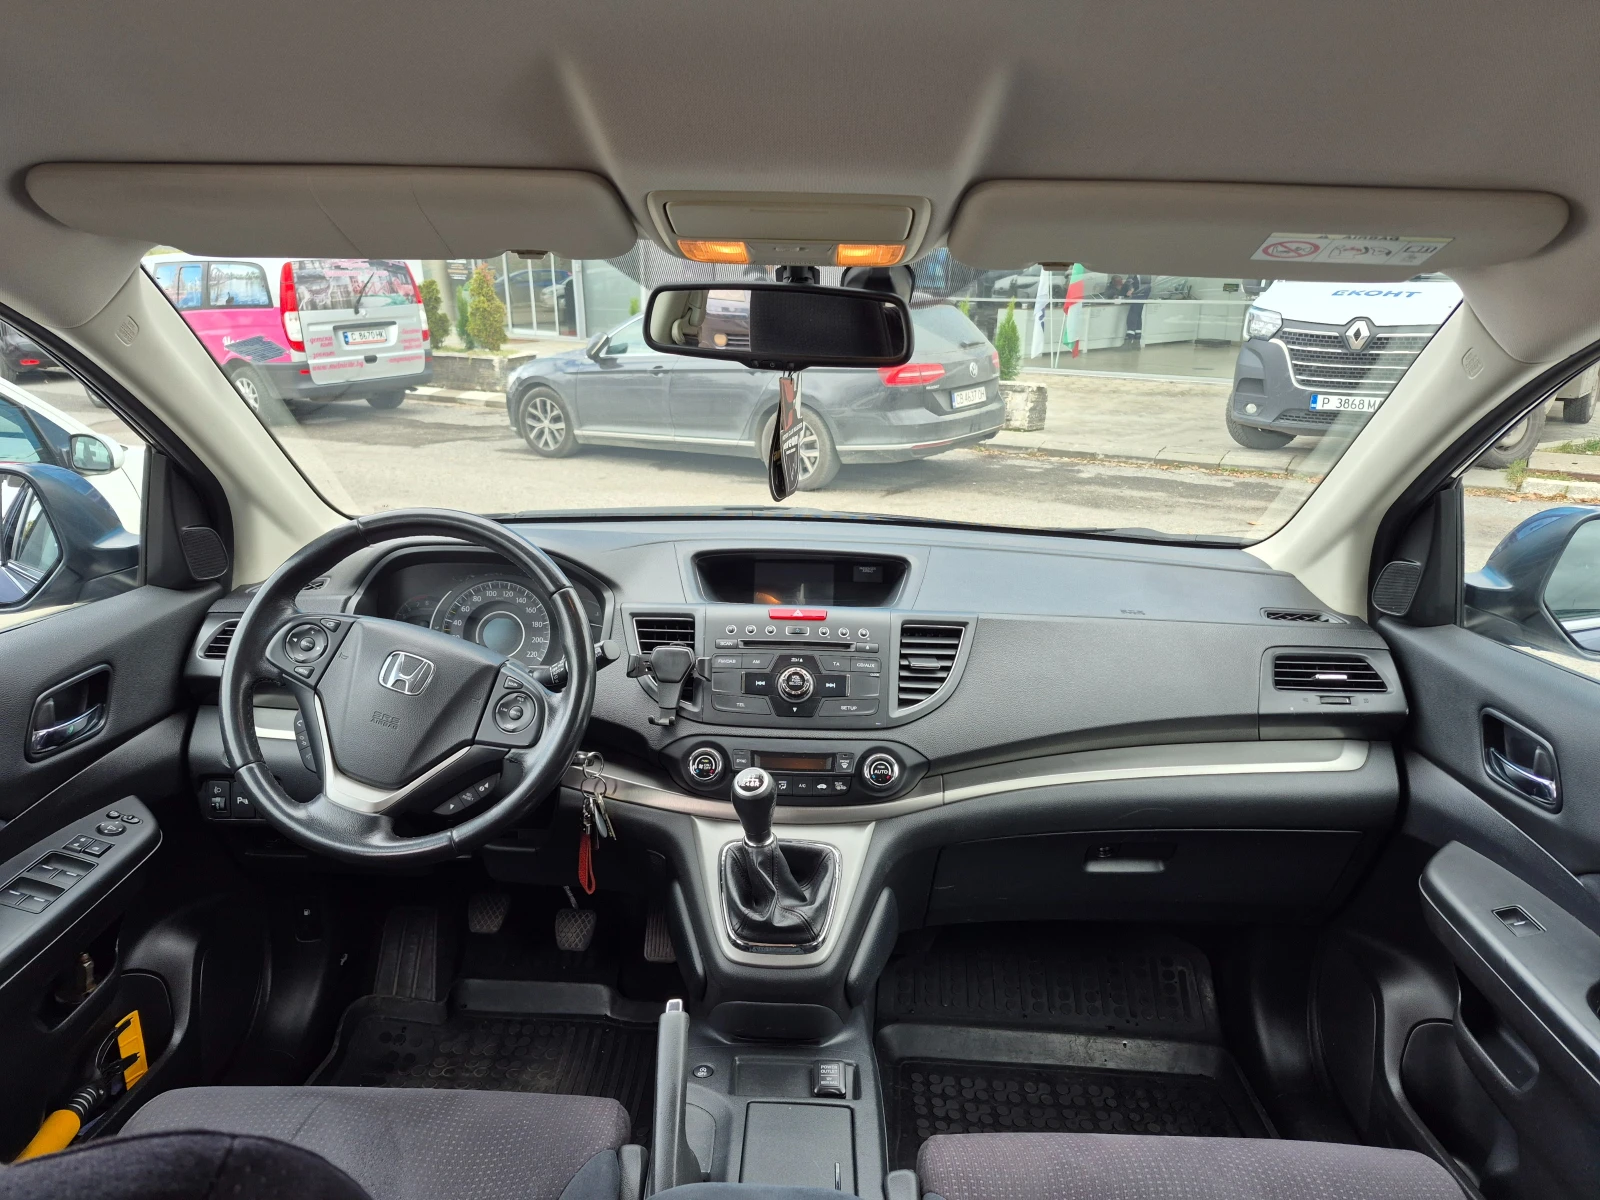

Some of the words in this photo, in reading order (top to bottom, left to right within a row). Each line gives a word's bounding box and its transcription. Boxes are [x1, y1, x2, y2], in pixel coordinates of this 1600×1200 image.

[1321, 397, 1330, 408] P
[1335, 398, 1365, 410] 3868
[525, 606, 537, 614] 160
